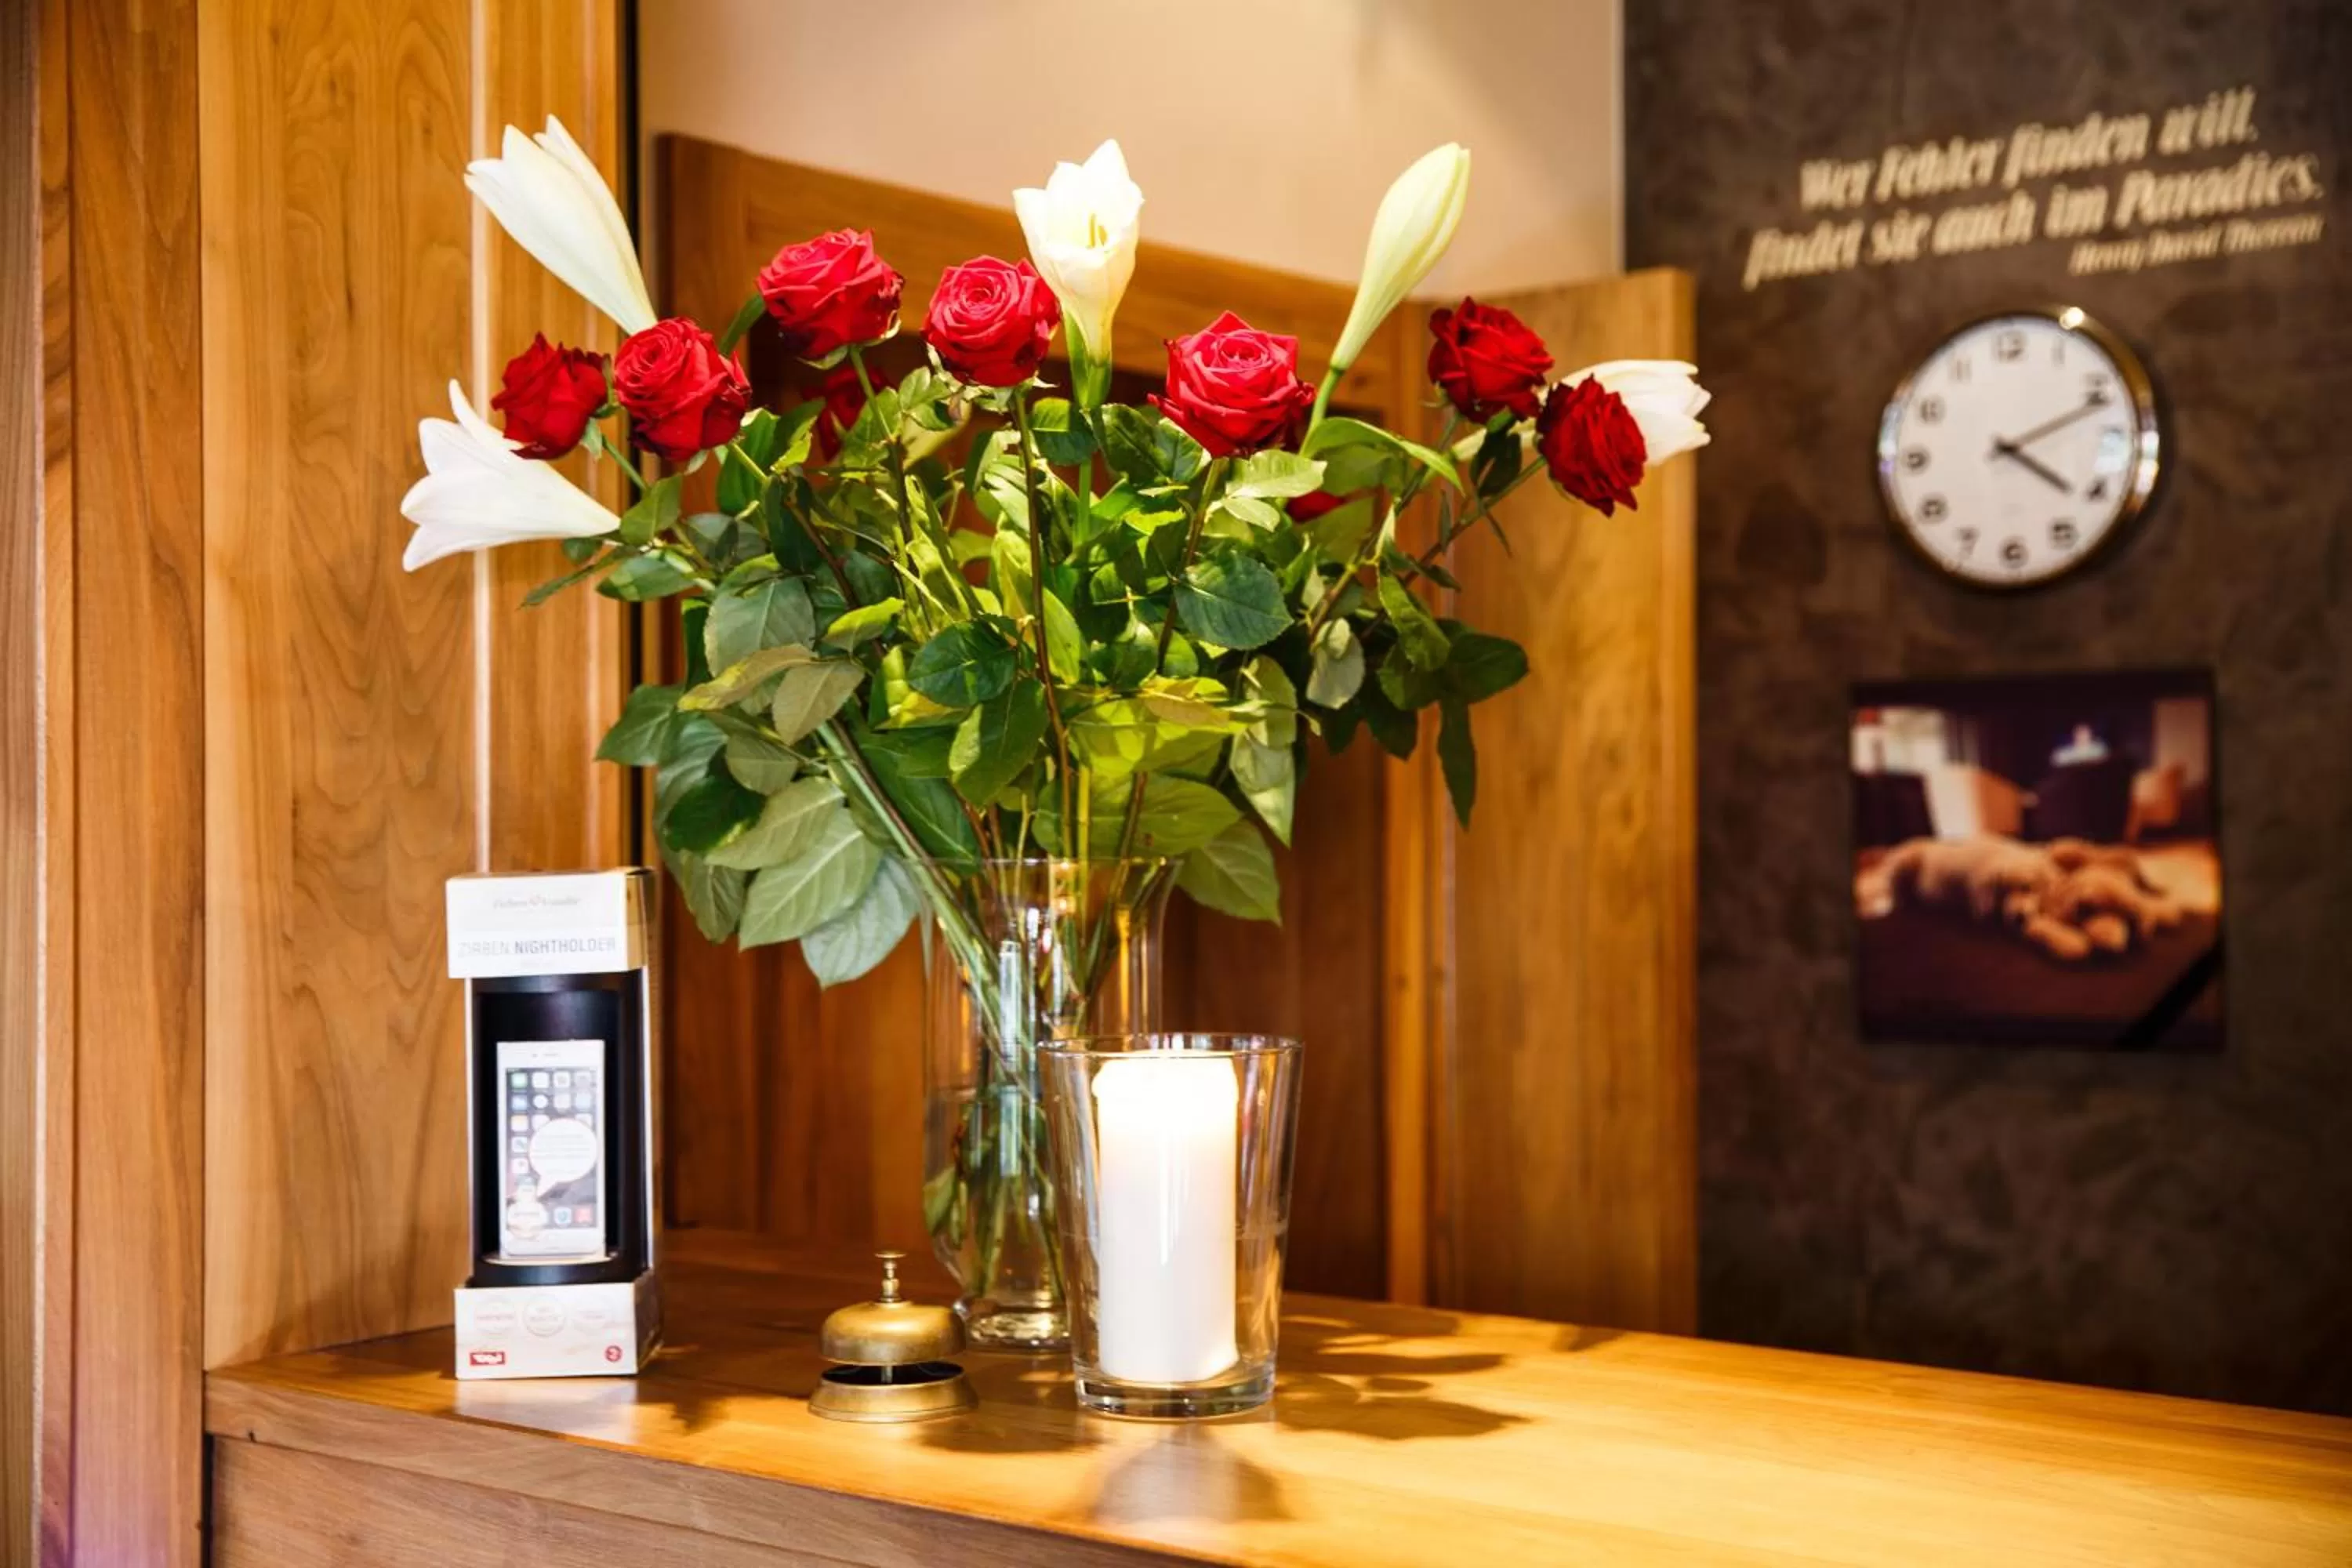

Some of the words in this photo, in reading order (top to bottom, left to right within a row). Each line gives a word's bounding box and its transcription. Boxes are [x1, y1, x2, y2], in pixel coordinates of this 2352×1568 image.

[2002, 111, 2151, 187] finden
[1866, 207, 1933, 265] sie
[1931, 188, 2037, 257] auch
[2042, 183, 2109, 240] im
[514, 937, 616, 955] NIGHTHOLDER
